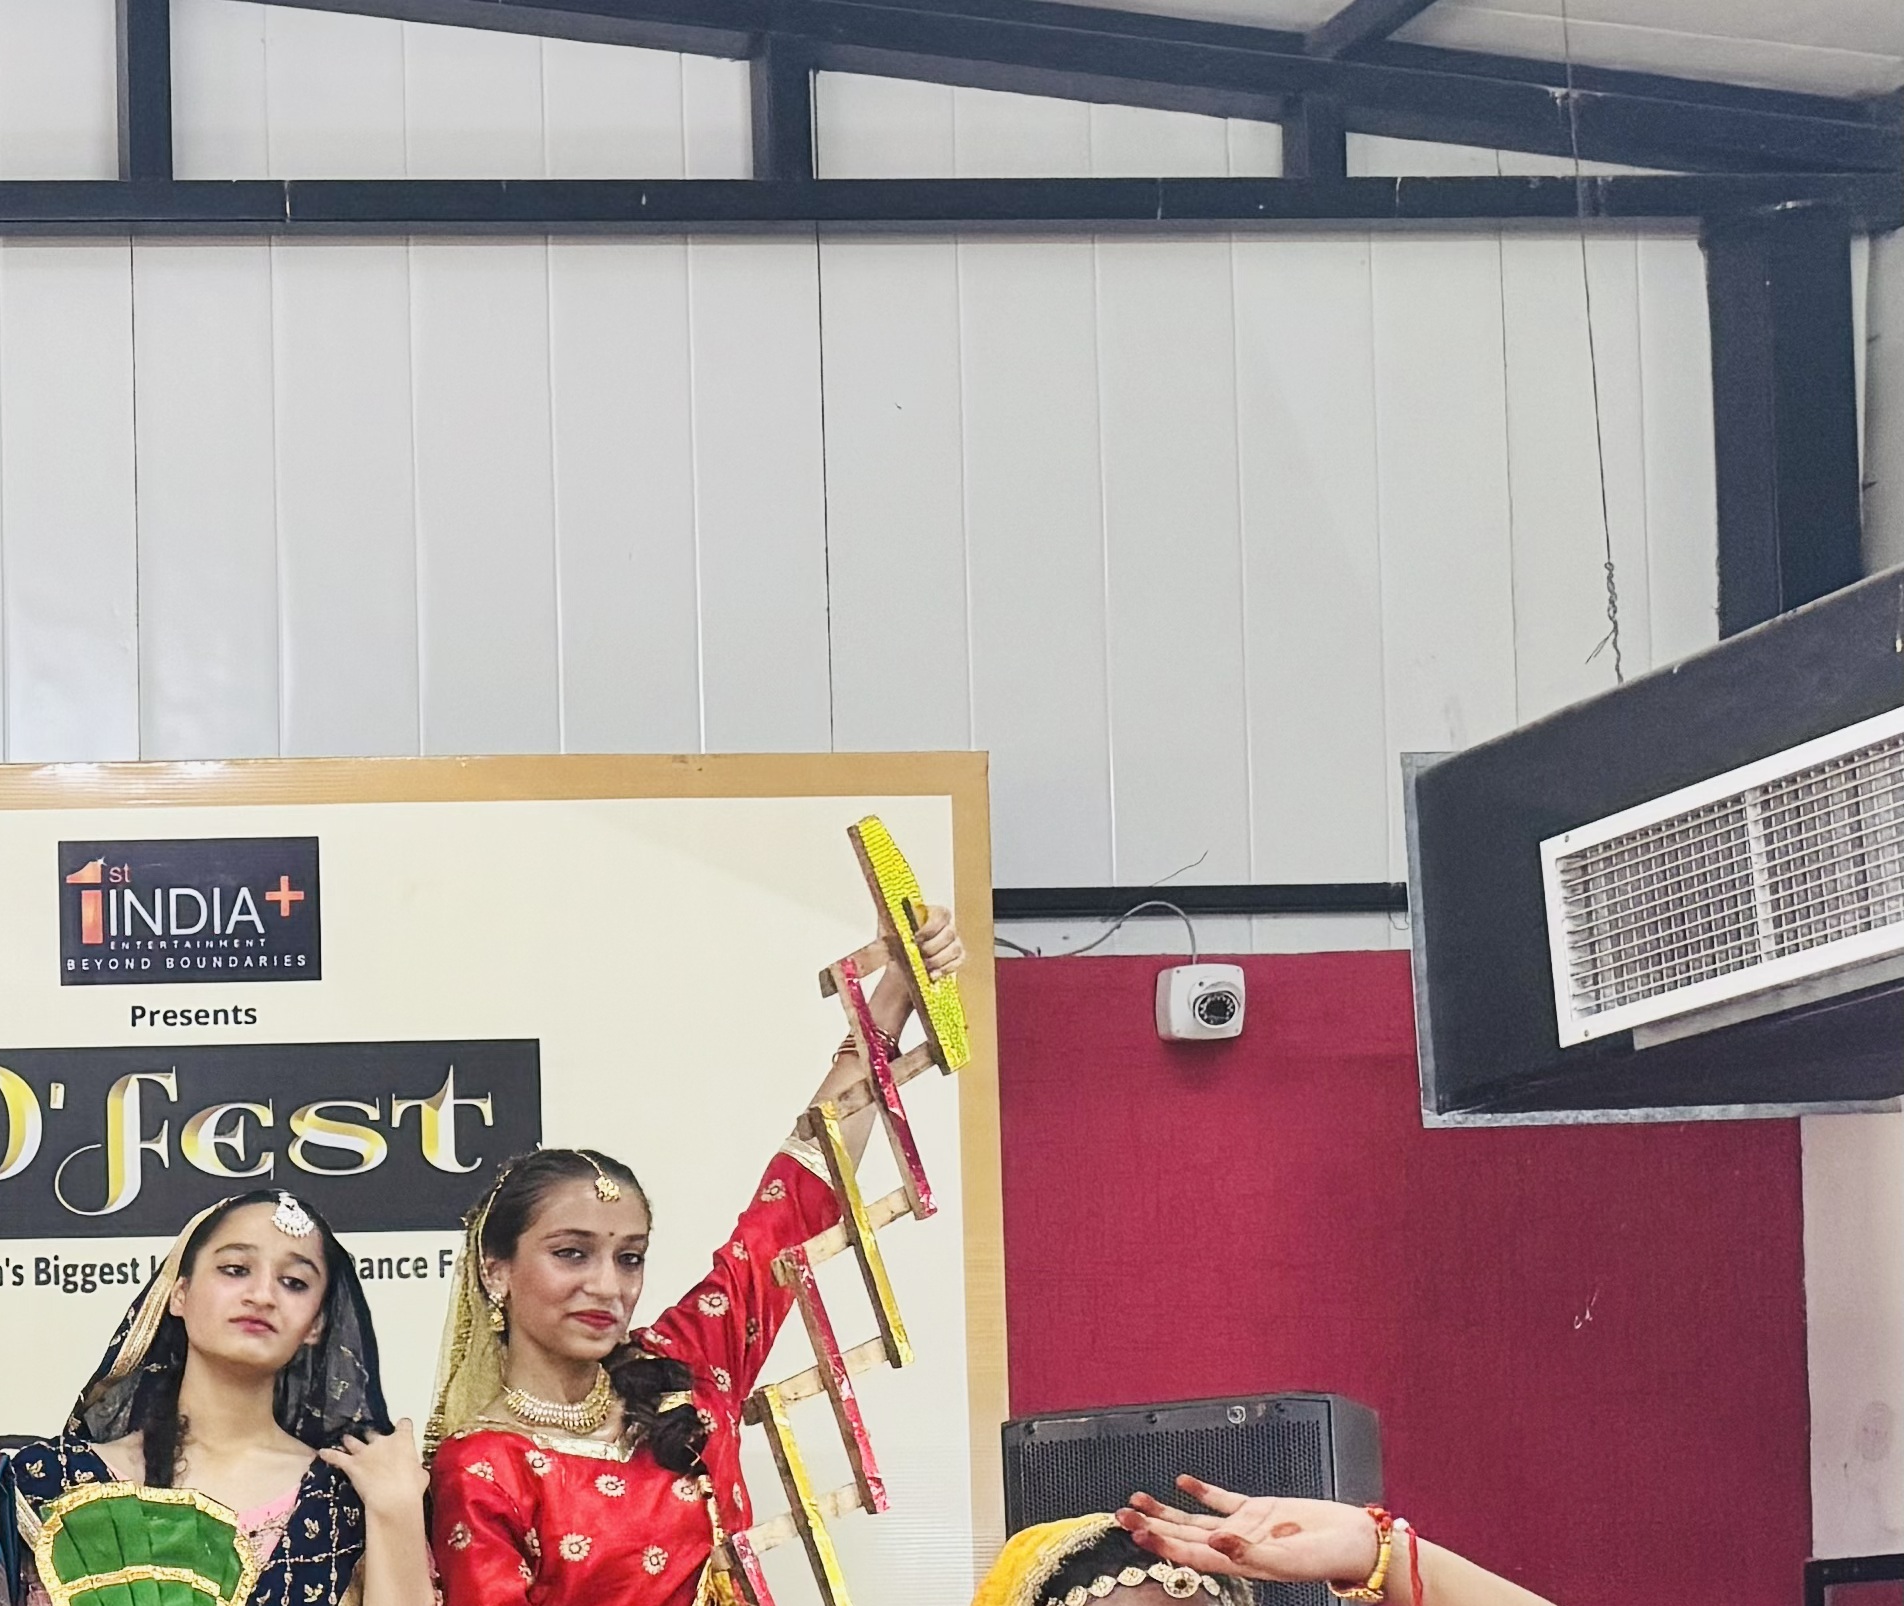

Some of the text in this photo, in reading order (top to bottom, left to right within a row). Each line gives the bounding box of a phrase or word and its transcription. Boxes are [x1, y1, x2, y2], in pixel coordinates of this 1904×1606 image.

[109, 938, 267, 950] ENTERTAINMENT
[66, 954, 307, 971] BEYOND BOUNDARIES
[130, 1004, 258, 1027] Presents
[34, 1255, 141, 1294] Biggest
[349, 1252, 428, 1280] ance
